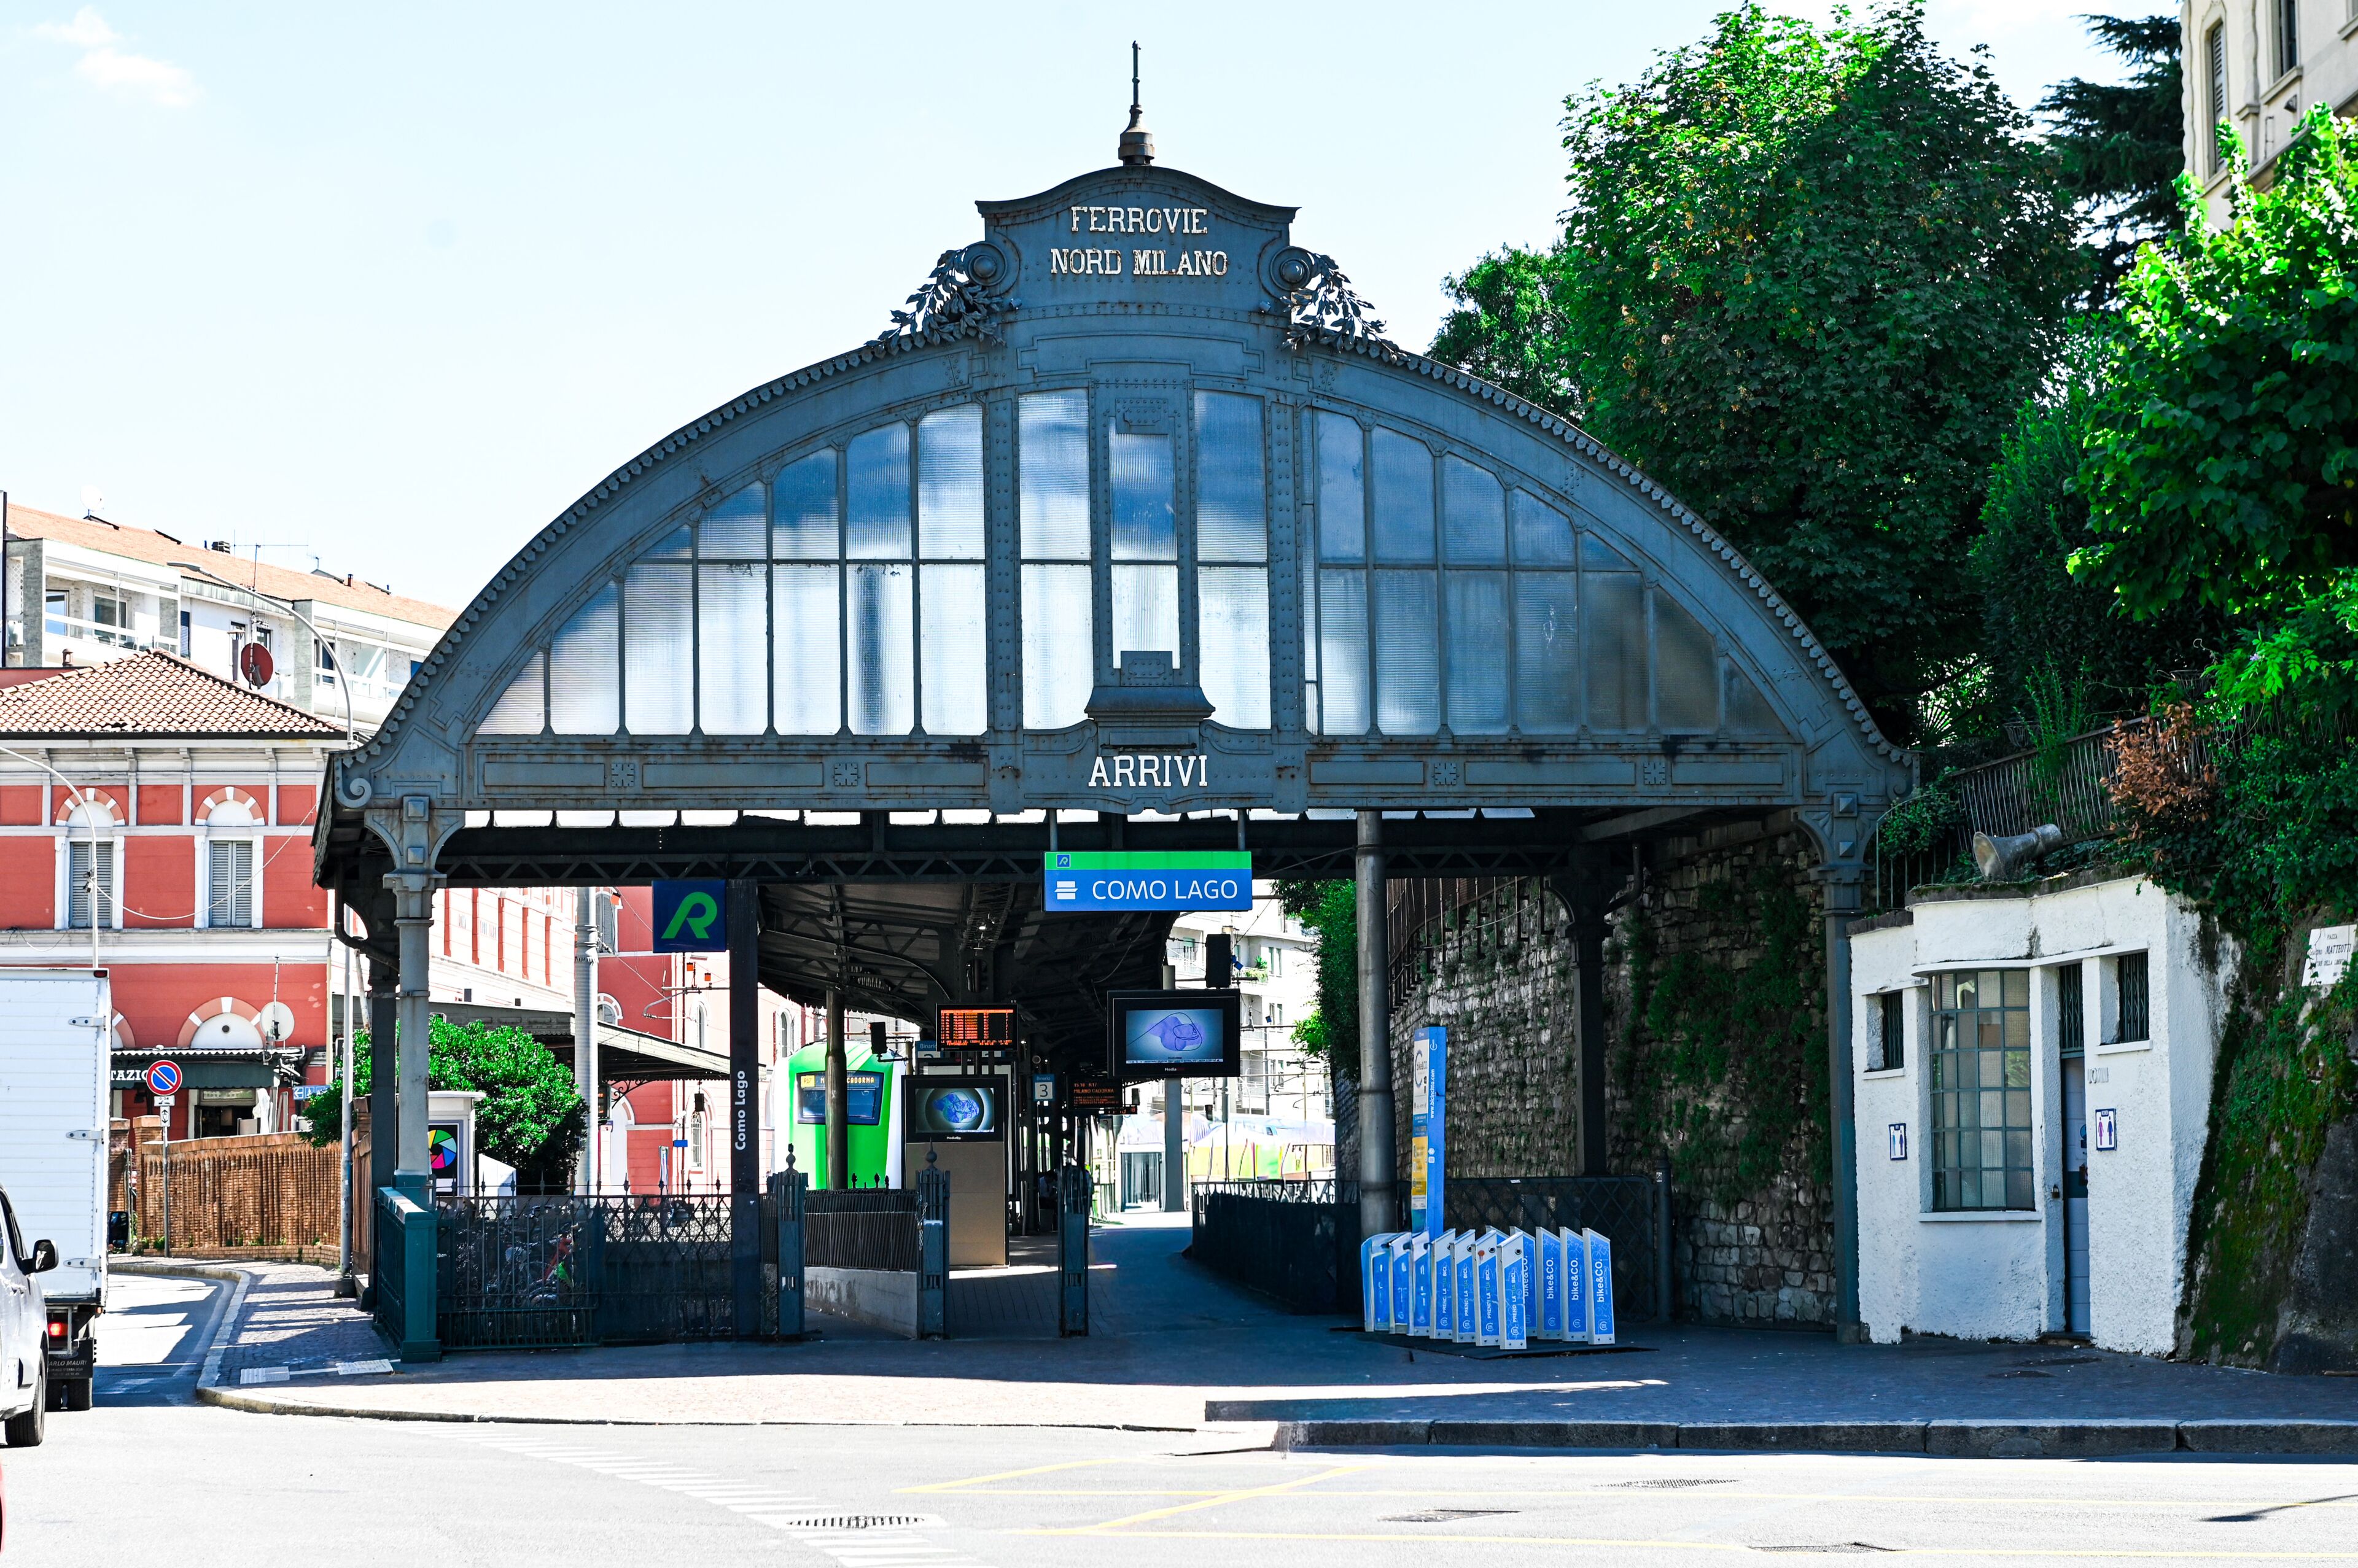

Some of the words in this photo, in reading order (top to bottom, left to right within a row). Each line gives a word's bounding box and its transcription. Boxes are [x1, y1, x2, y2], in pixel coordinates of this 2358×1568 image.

[1071, 206, 1208, 234] FERROVIE
[1051, 248, 1123, 274] NORD
[1132, 249, 1228, 276] MILANO
[1088, 755, 1208, 787] ARRIVI
[1092, 880, 1166, 899] COMO
[1175, 879, 1238, 899] LAGO
[2325, 944, 2351, 954] MATTEOTTI
[111, 1069, 147, 1081] TAZIO
[734, 1070, 749, 1105] Lago
[1039, 1084, 1048, 1098] 3
[735, 1109, 746, 1150] Como
[1546, 1257, 1554, 1299] bike&CO.
[1570, 1257, 1579, 1300] bike&CO.
[1595, 1259, 1605, 1303] bike&CO.
